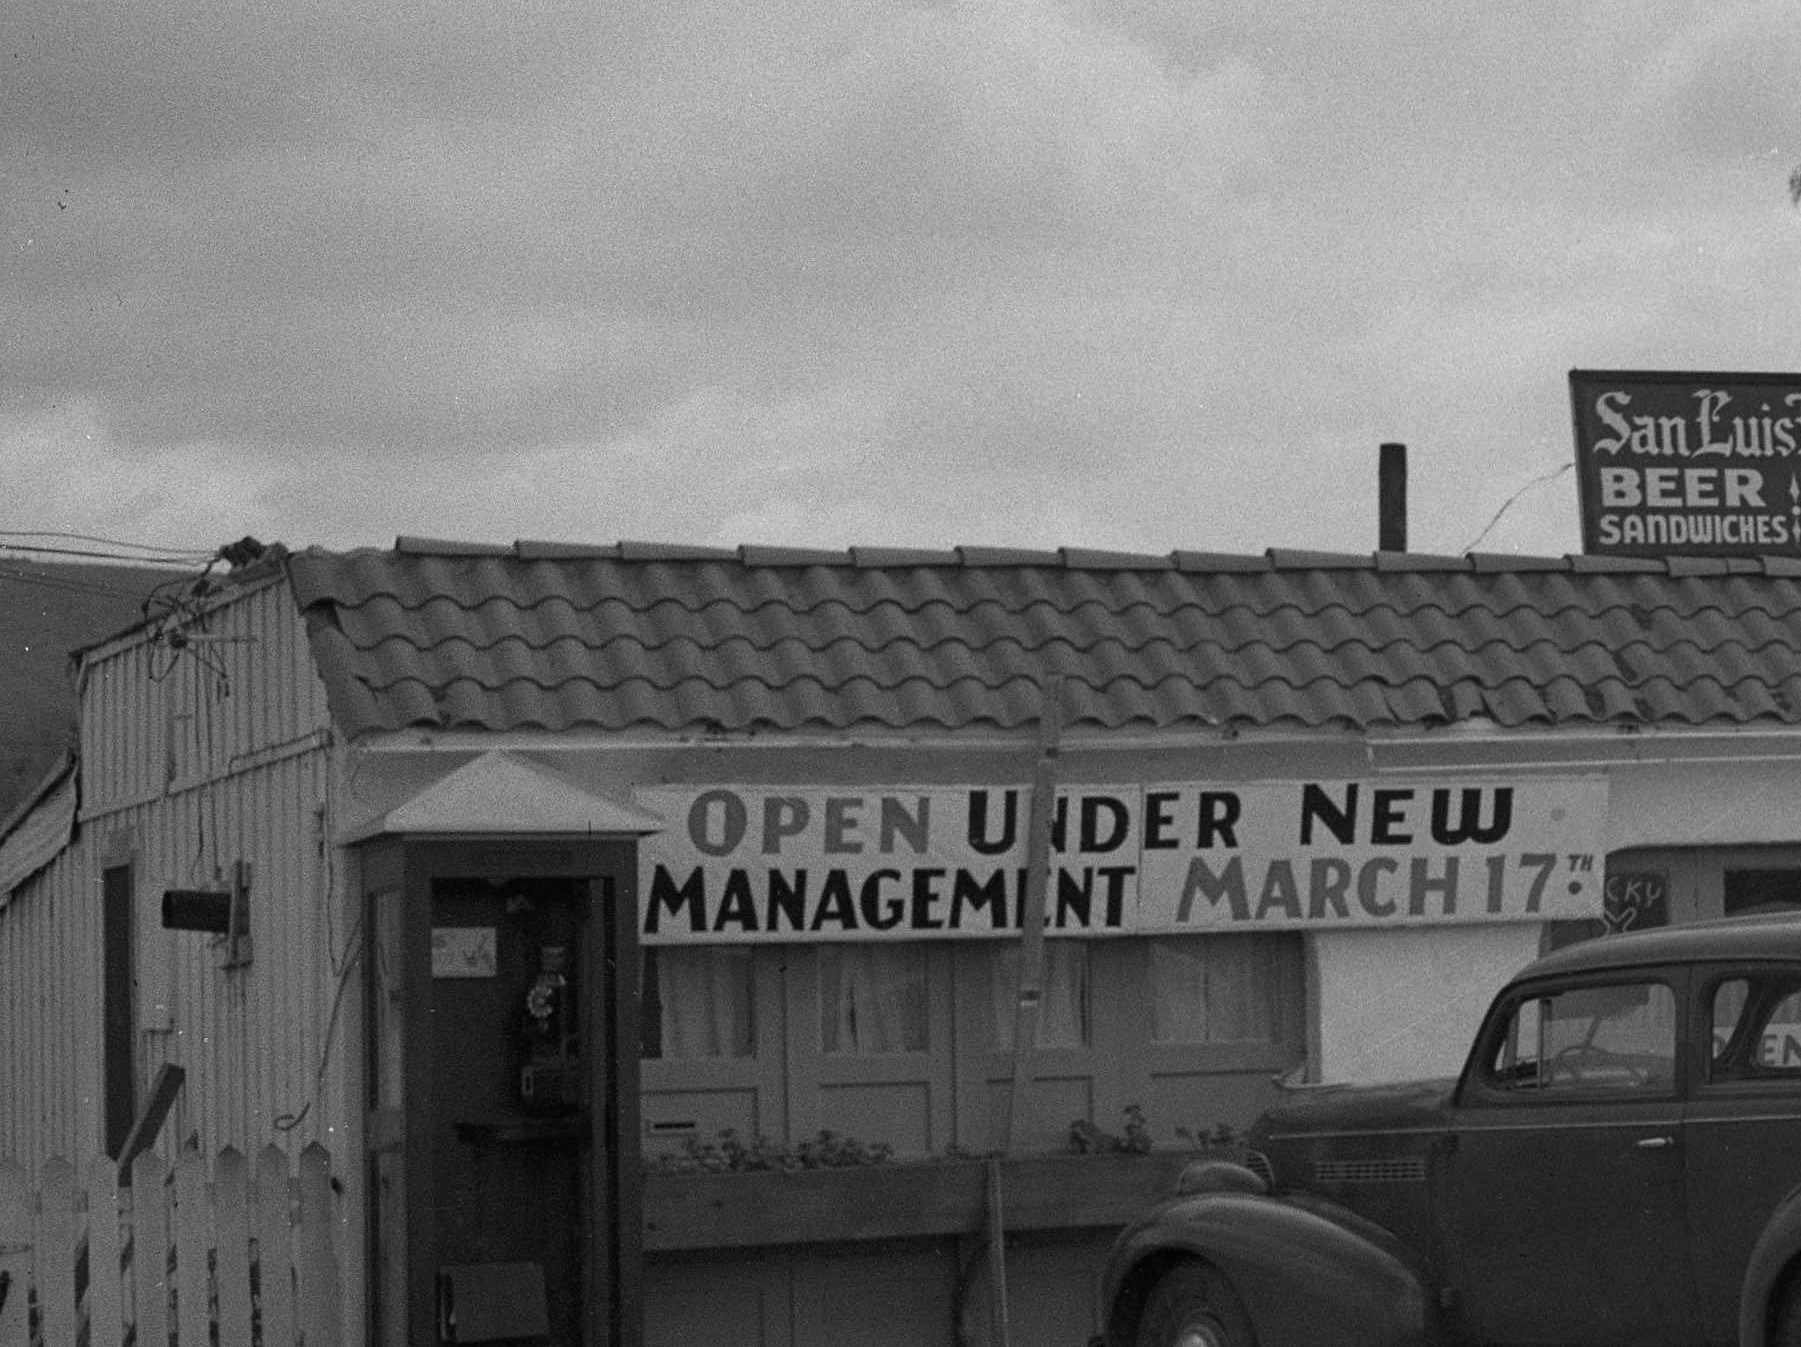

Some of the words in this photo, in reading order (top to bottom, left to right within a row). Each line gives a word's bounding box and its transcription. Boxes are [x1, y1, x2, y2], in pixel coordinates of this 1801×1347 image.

[1593, 390, 1692, 456] San
[1692, 388, 1799, 458] Luis
[1600, 467, 1767, 507] BEER
[1599, 513, 1789, 545] SANDWICHES
[686, 788, 930, 858] OPEN
[1298, 782, 1515, 846] NEW
[1175, 854, 1460, 923] MARCH
[1606, 875, 1662, 908] CKY
